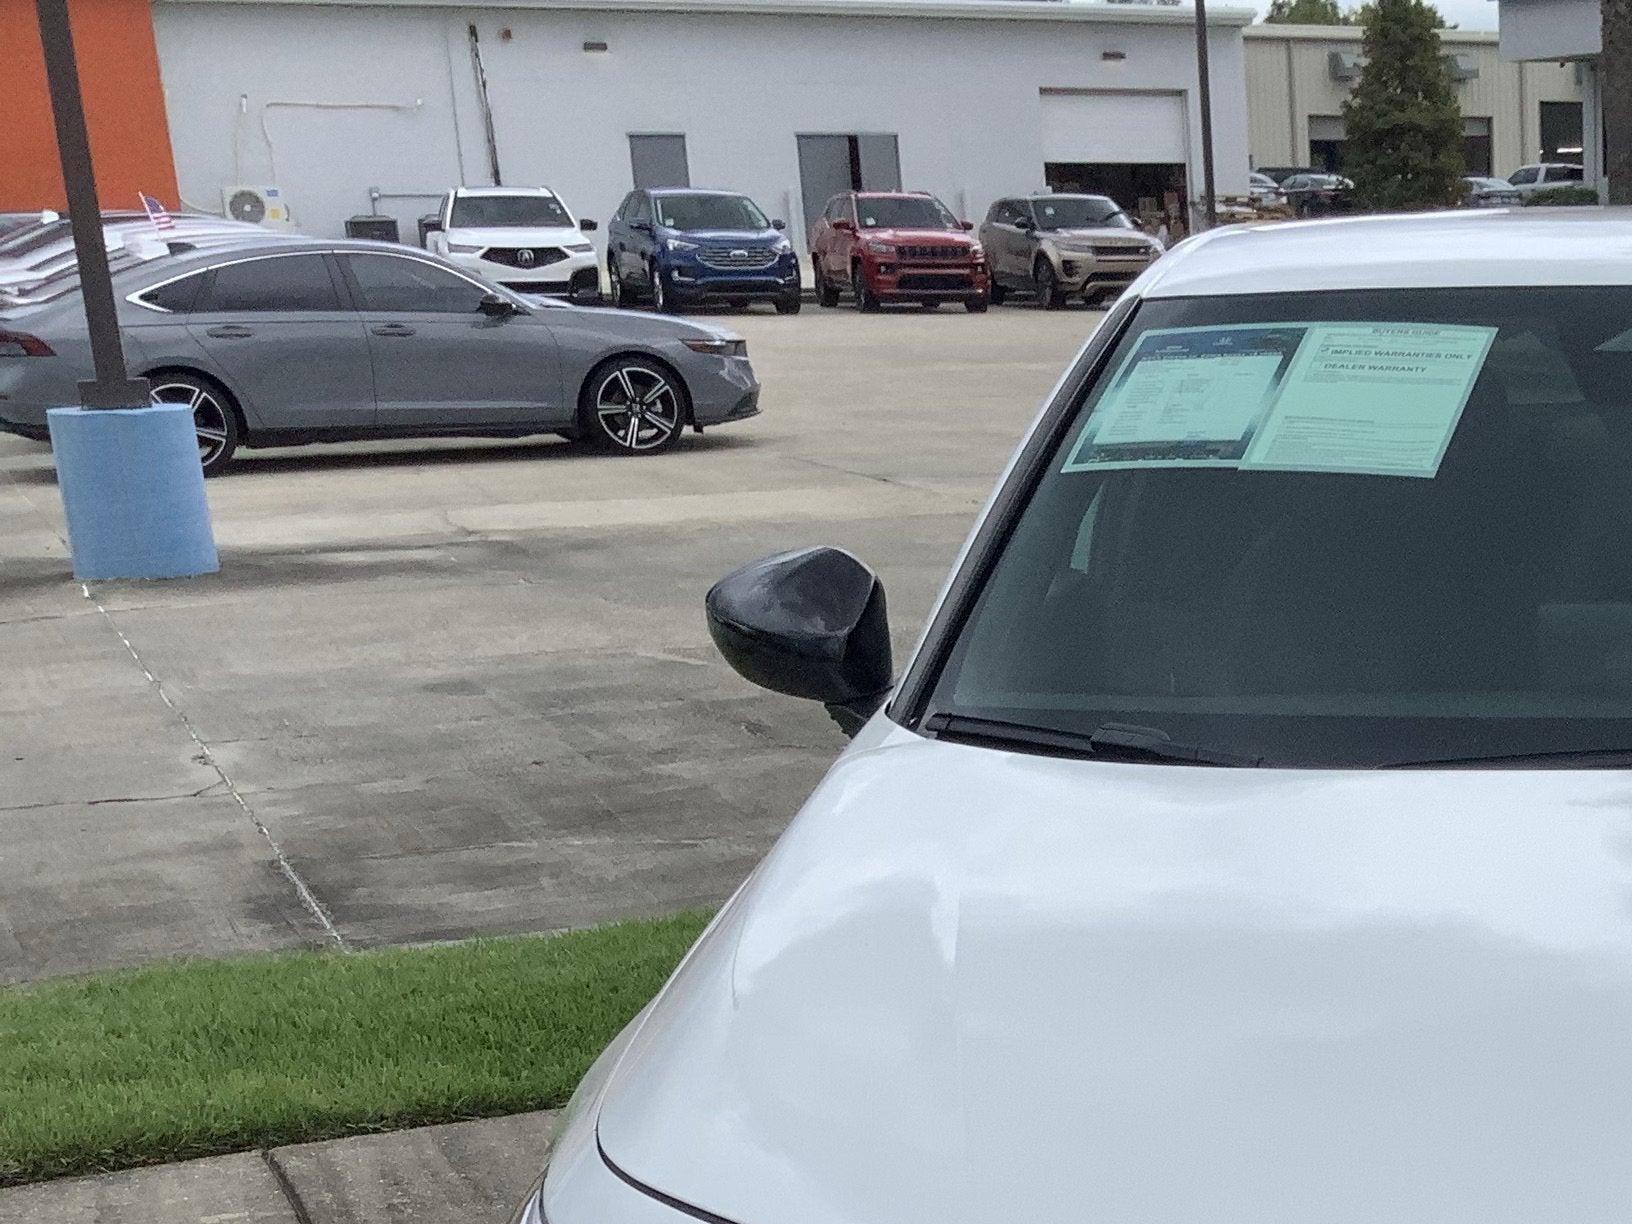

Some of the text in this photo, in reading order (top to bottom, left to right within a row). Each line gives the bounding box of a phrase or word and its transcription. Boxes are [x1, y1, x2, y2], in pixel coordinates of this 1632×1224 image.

[1330, 349, 1373, 357] IMPLIED
[1374, 350, 1442, 359] WARRANTIES
[1324, 363, 1427, 373] DEALER WARRANTY
